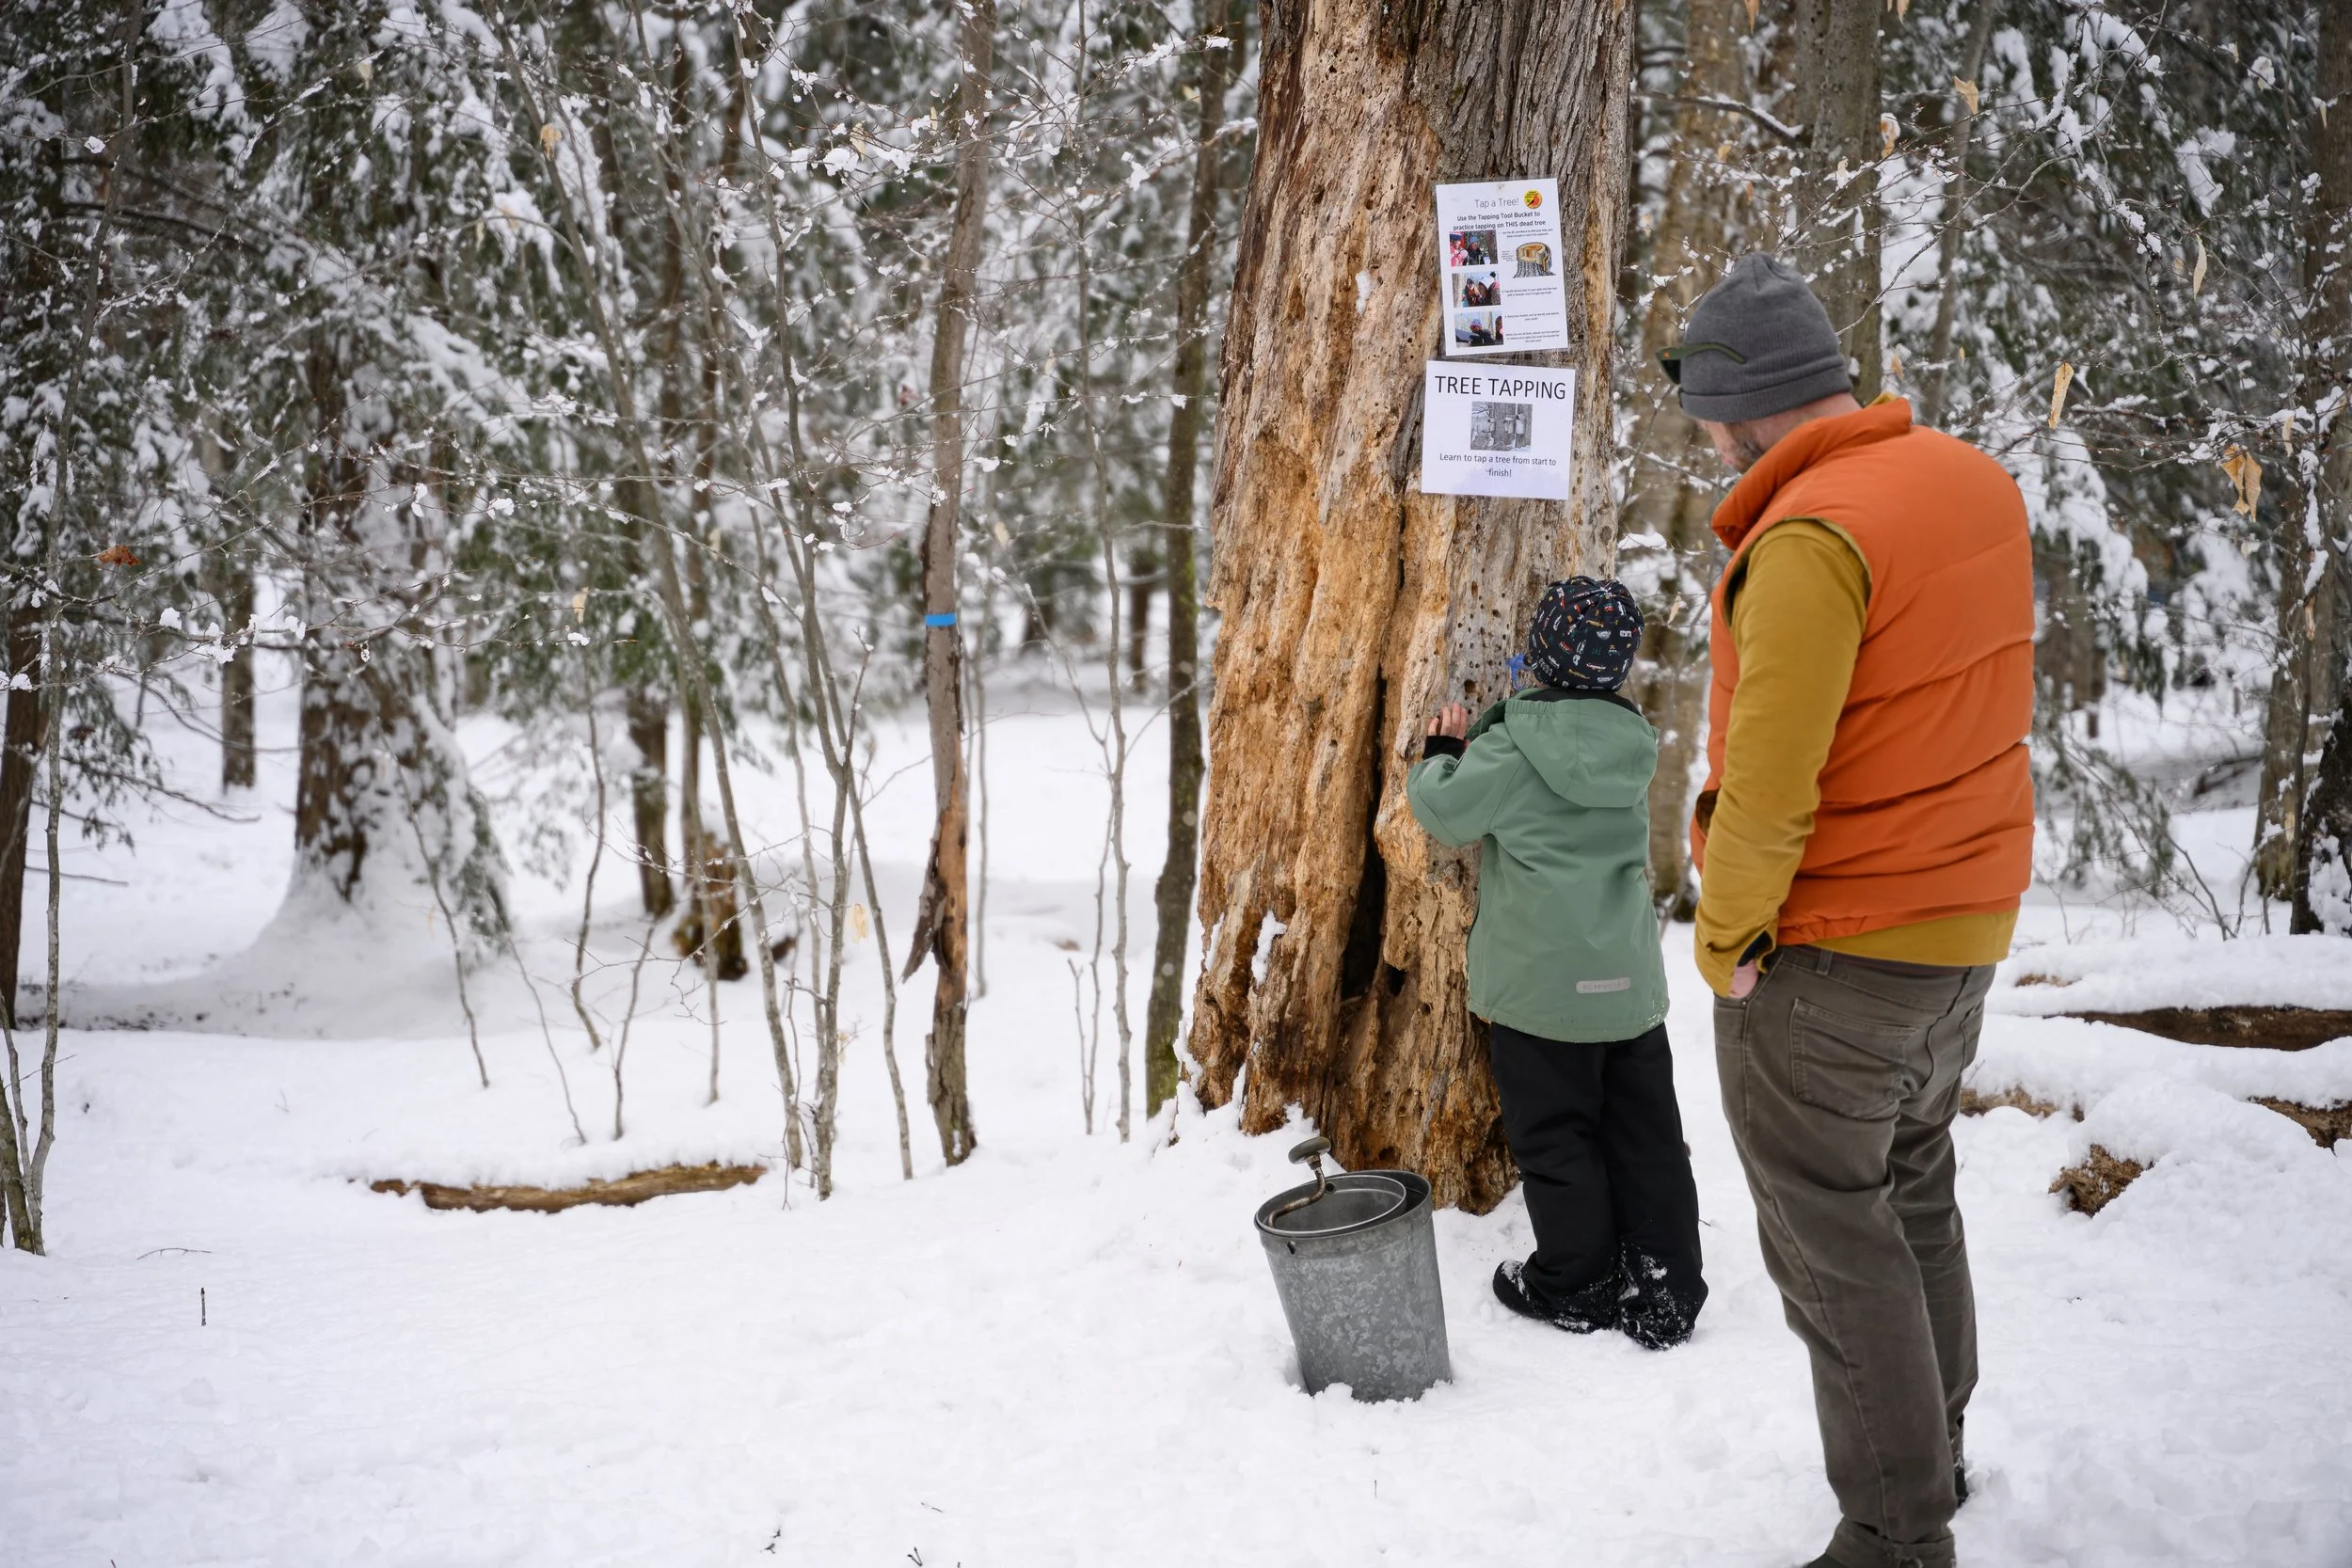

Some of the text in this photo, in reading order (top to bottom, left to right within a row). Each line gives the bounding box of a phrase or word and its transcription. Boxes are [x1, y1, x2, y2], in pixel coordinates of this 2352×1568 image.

[1475, 198, 1489, 209] Tap
[1498, 198, 1519, 206] Tree!
[1435, 376, 1566, 399] TREE TAPPING
[1439, 453, 1462, 461] Learn
[1474, 455, 1487, 464] tap
[1512, 456, 1530, 464] from
[1488, 468, 1512, 477] finish!
